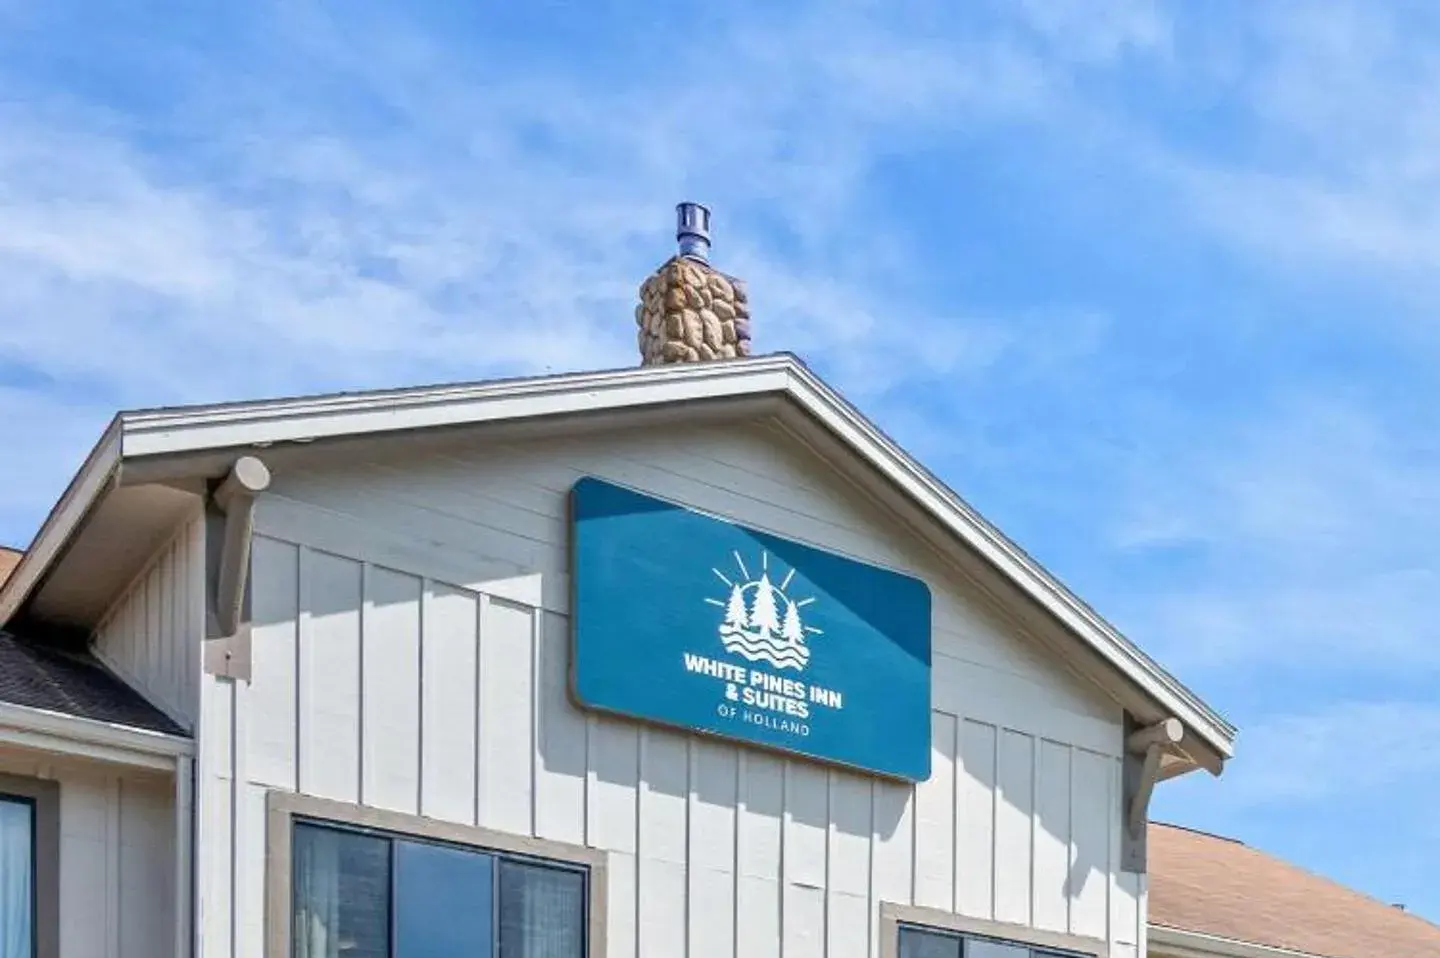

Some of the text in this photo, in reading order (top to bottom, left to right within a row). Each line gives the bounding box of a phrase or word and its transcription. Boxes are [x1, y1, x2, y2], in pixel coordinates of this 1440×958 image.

[684, 653, 842, 709] WHITE PINES INN
[725, 683, 809, 719] & SUITES
[717, 703, 809, 736] OF HOLLAND
